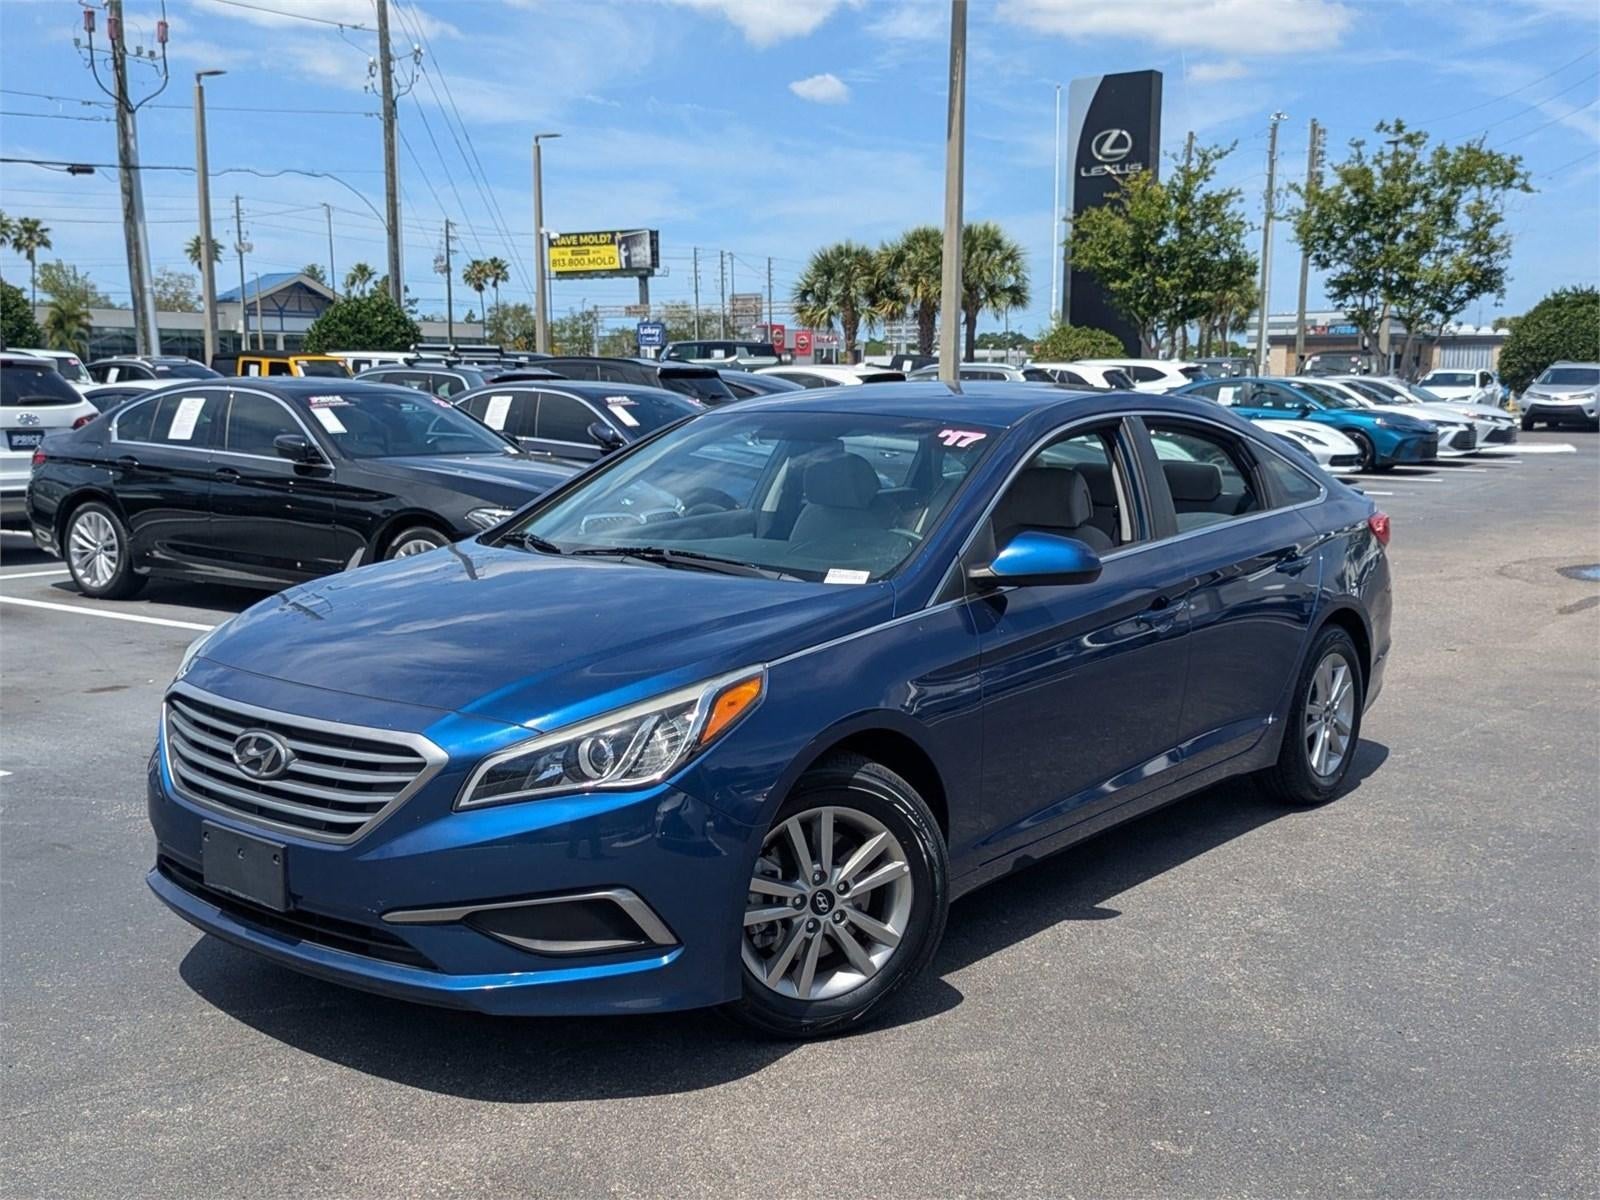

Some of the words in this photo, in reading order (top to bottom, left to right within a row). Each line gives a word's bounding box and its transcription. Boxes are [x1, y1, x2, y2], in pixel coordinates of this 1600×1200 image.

[1080, 162, 1143, 177] LEXUS
[579, 233, 612, 245] MOLD?
[552, 256, 616, 268] 813.800.MOLD
